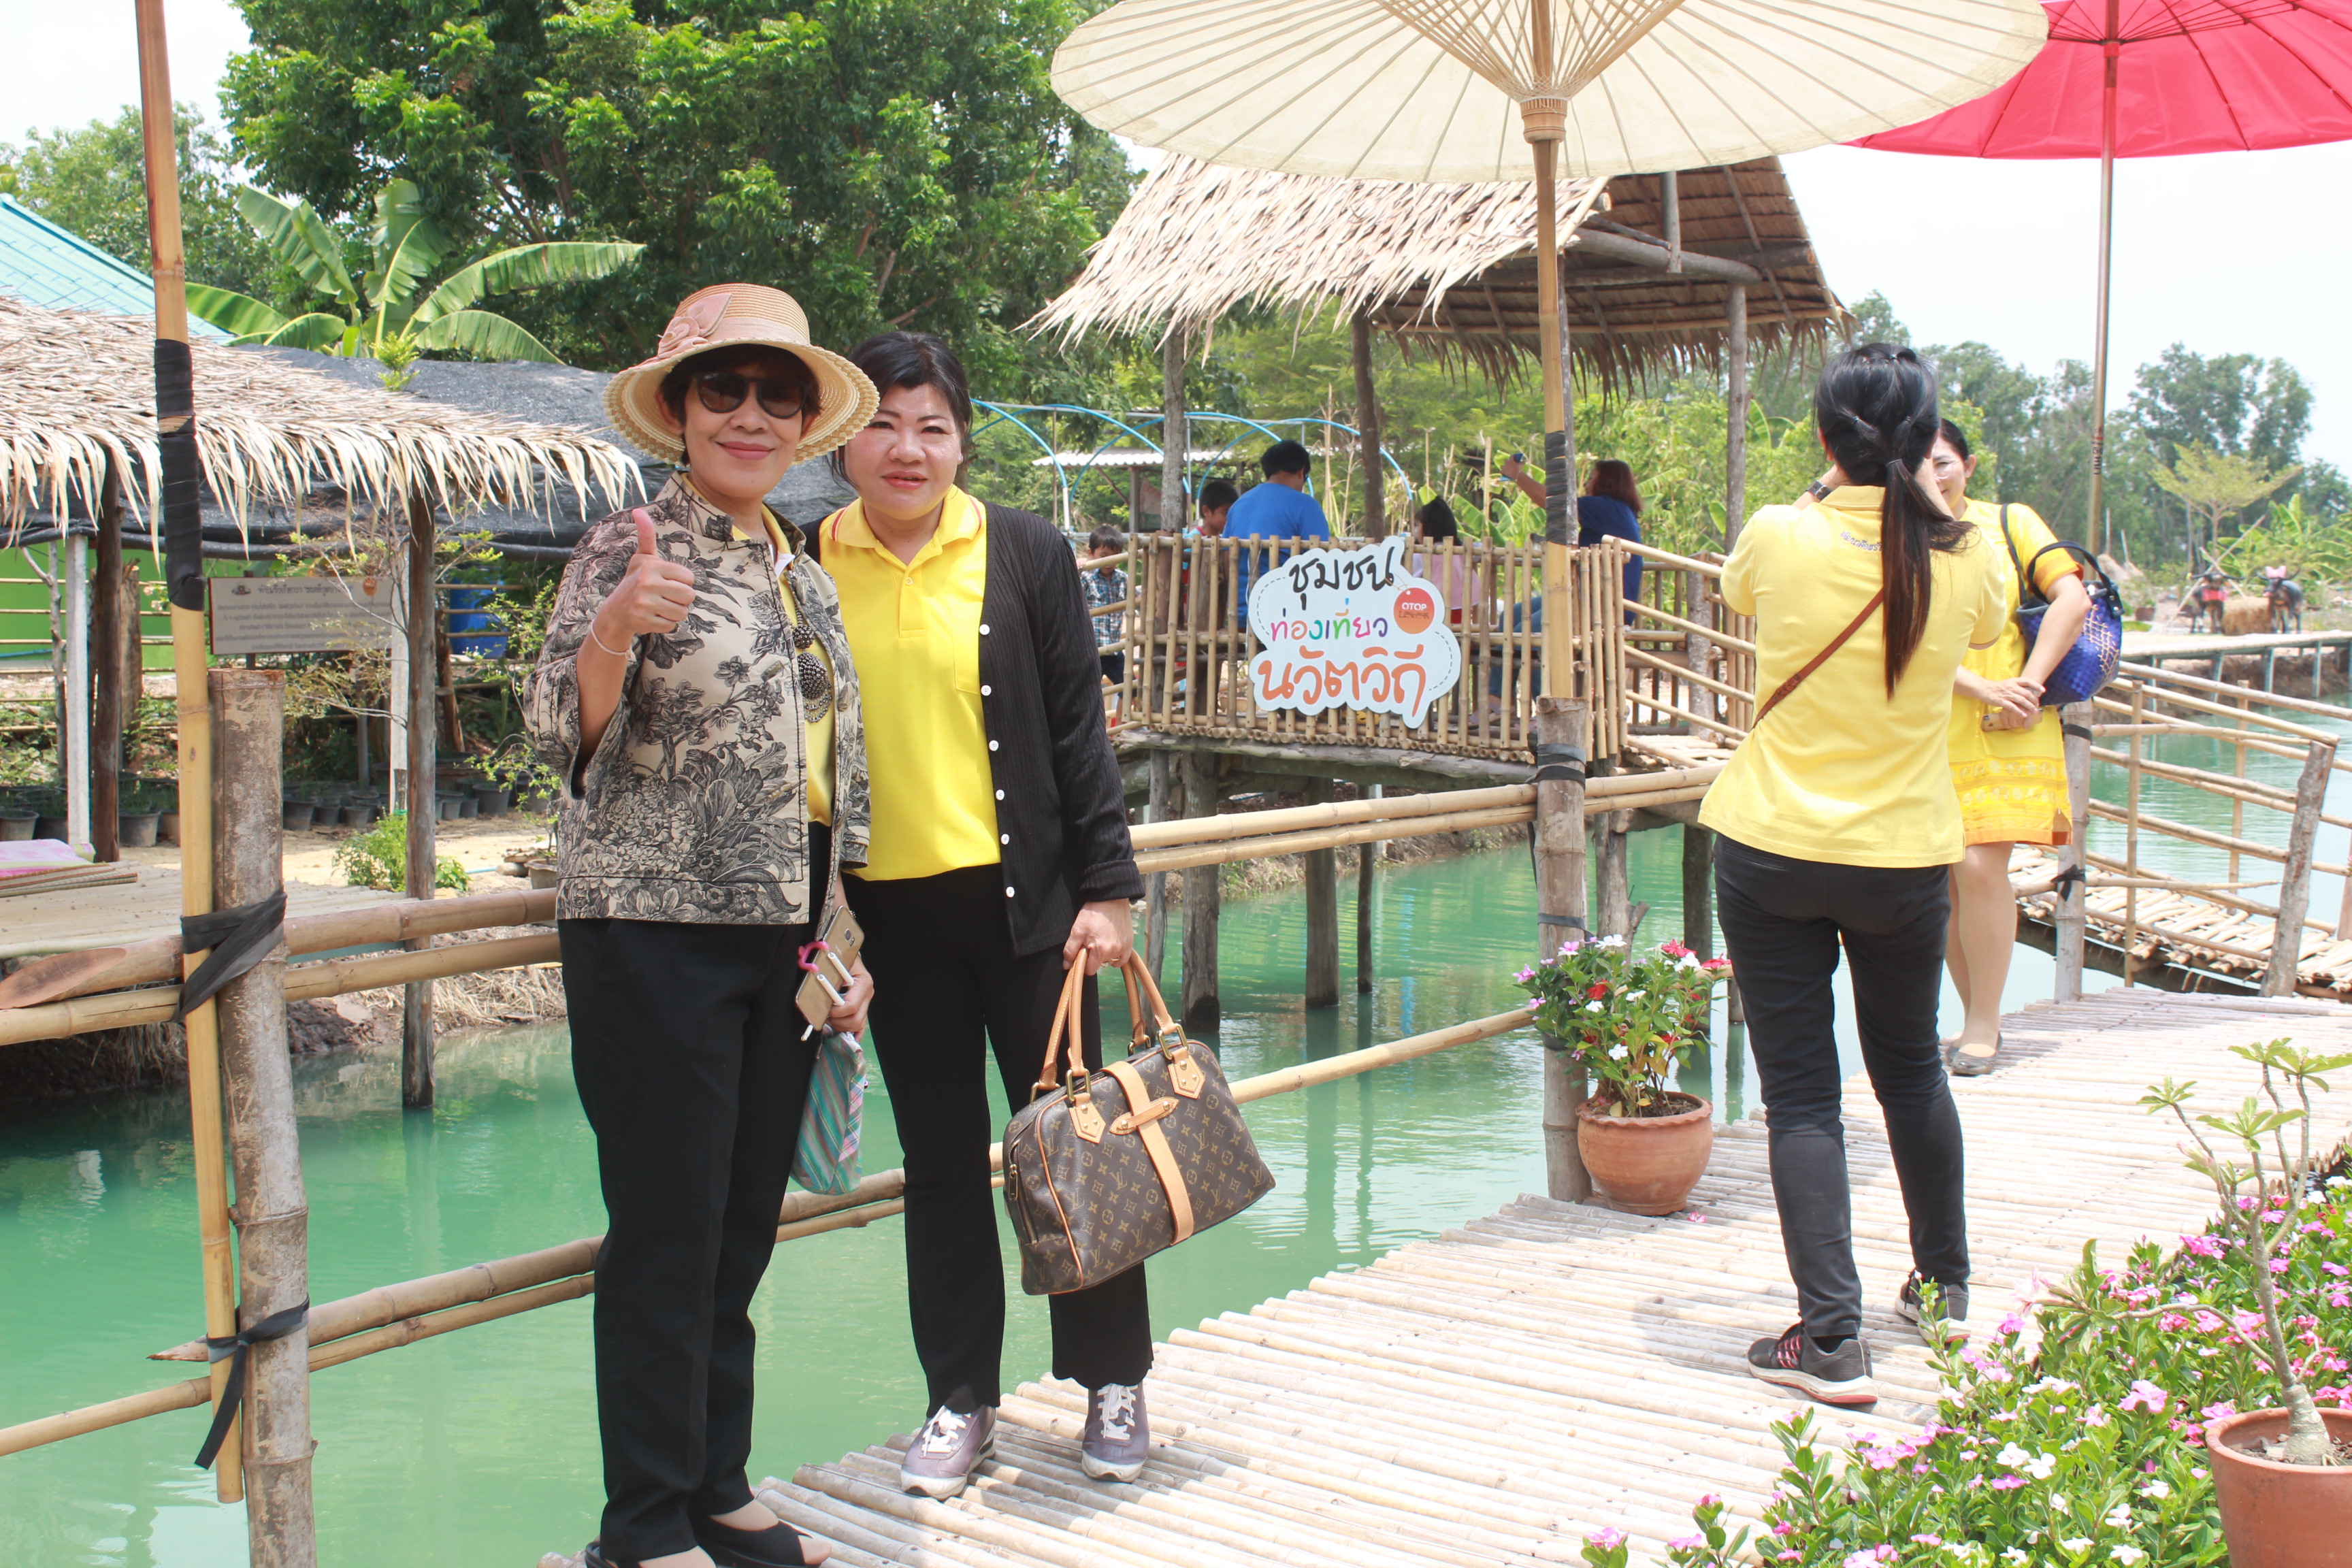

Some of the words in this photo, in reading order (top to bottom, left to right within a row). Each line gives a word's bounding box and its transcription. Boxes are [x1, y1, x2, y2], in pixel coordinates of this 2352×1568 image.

[1288, 546, 1395, 611] ชุมชน
[1270, 598, 1388, 642] ท่องเที่ยว
[1401, 602, 1428, 612] OTOP
[1258, 644, 1427, 718] นวัตวิถี
